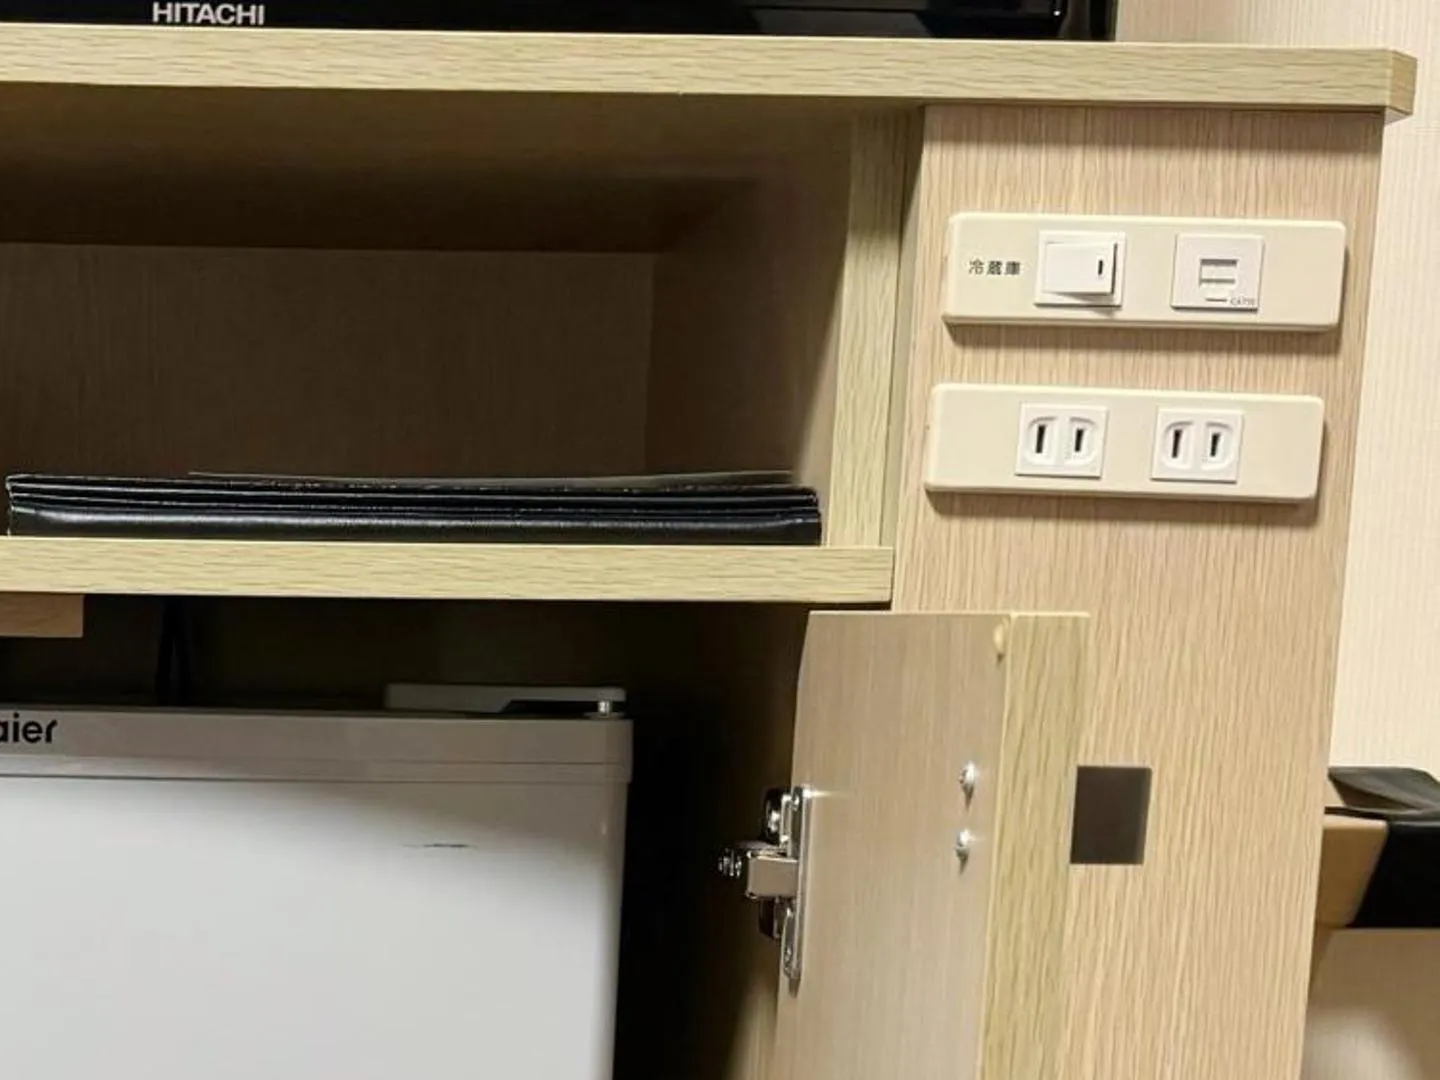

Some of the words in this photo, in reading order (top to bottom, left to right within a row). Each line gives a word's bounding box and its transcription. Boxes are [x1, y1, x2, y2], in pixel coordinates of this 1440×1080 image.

[152, 1, 266, 26] HITACHI
[968, 257, 1021, 276] 冷蔵庫
